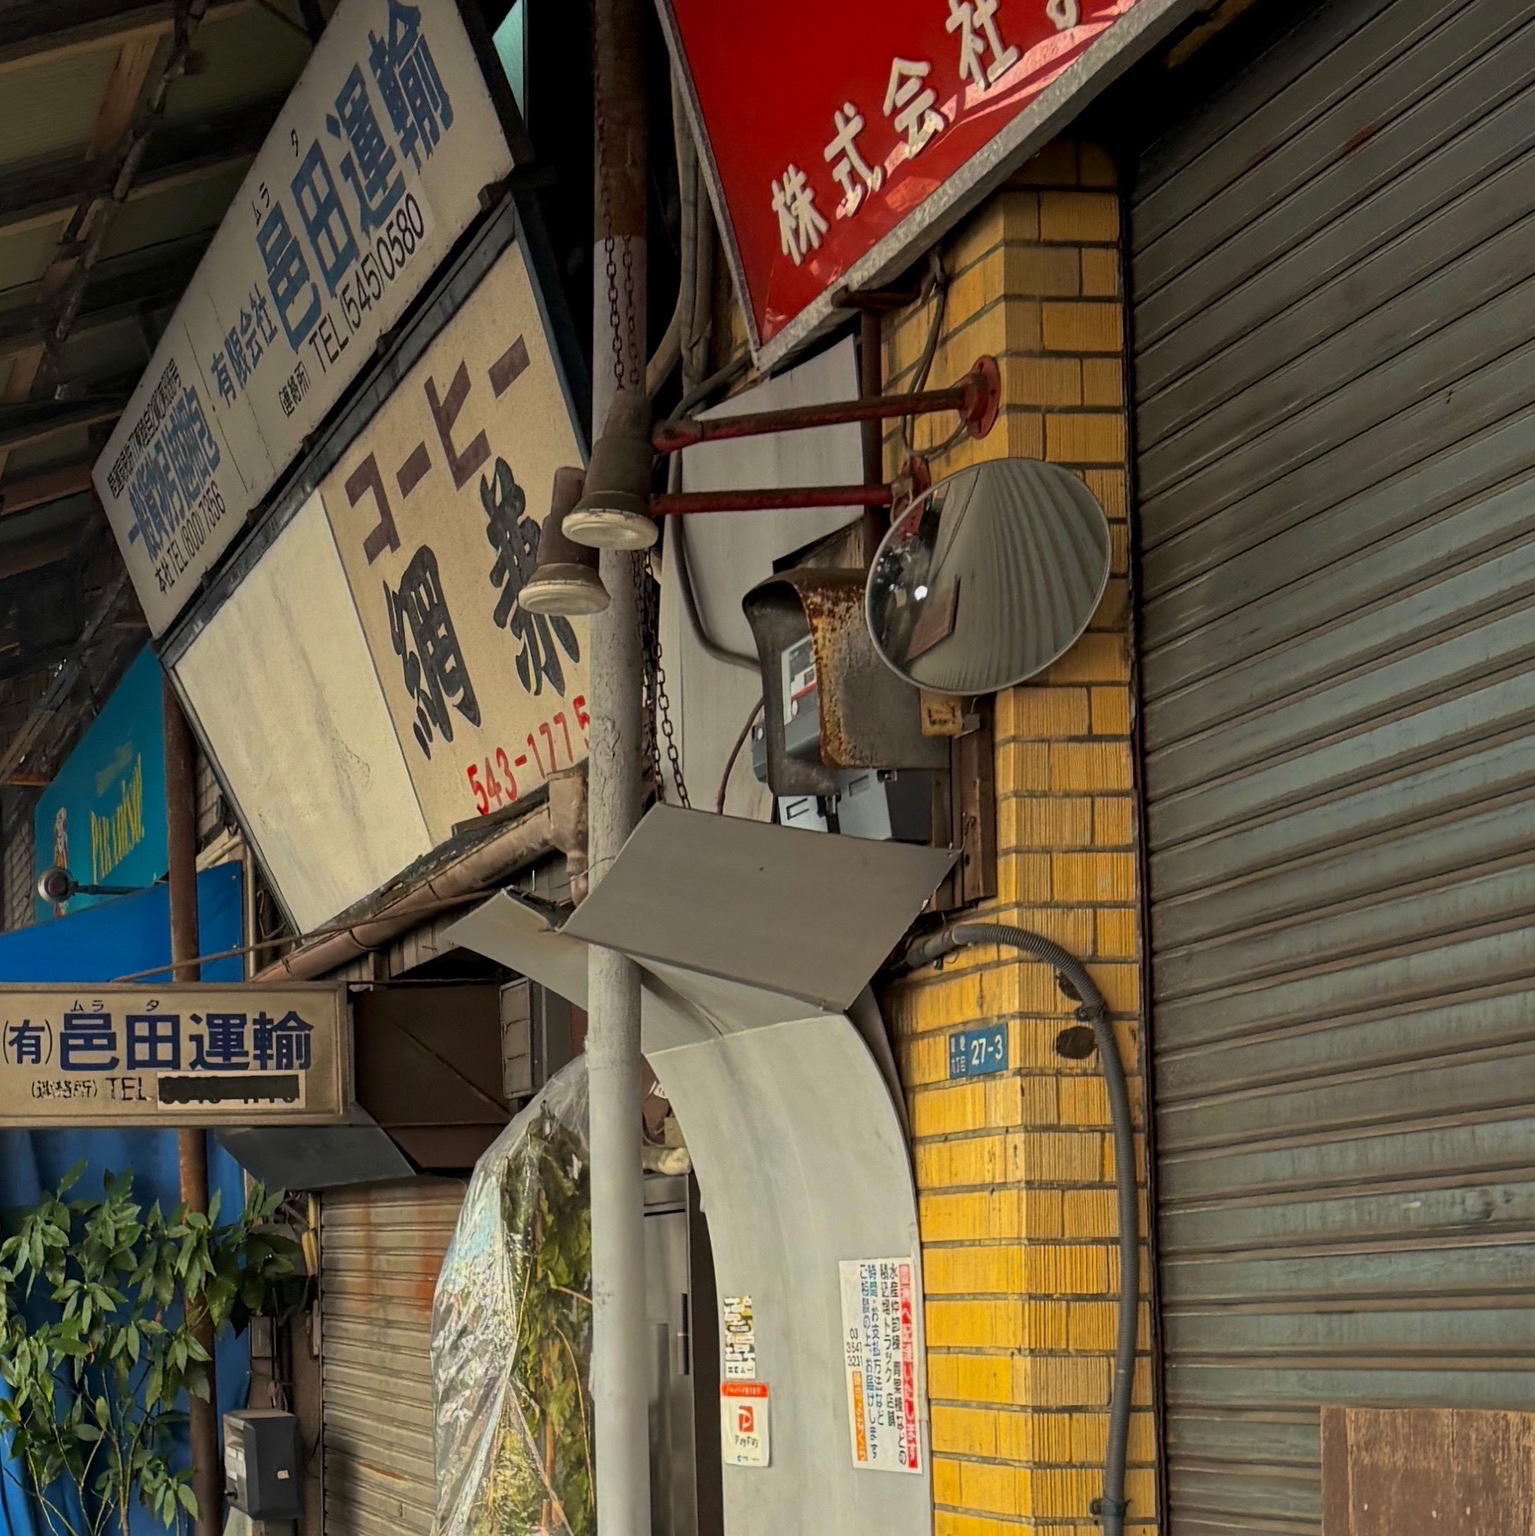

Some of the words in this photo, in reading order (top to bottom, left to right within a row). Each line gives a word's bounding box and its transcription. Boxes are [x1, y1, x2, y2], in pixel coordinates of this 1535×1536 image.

[210, 282, 278, 409] 有限会社
[256, 0, 454, 354] 邑田運輸
[308, 315, 350, 375] TEL
[345, 335, 530, 565] コーヒー
[971, 1034, 1004, 1066] 27-3
[105, 1077, 147, 1101] TEL
